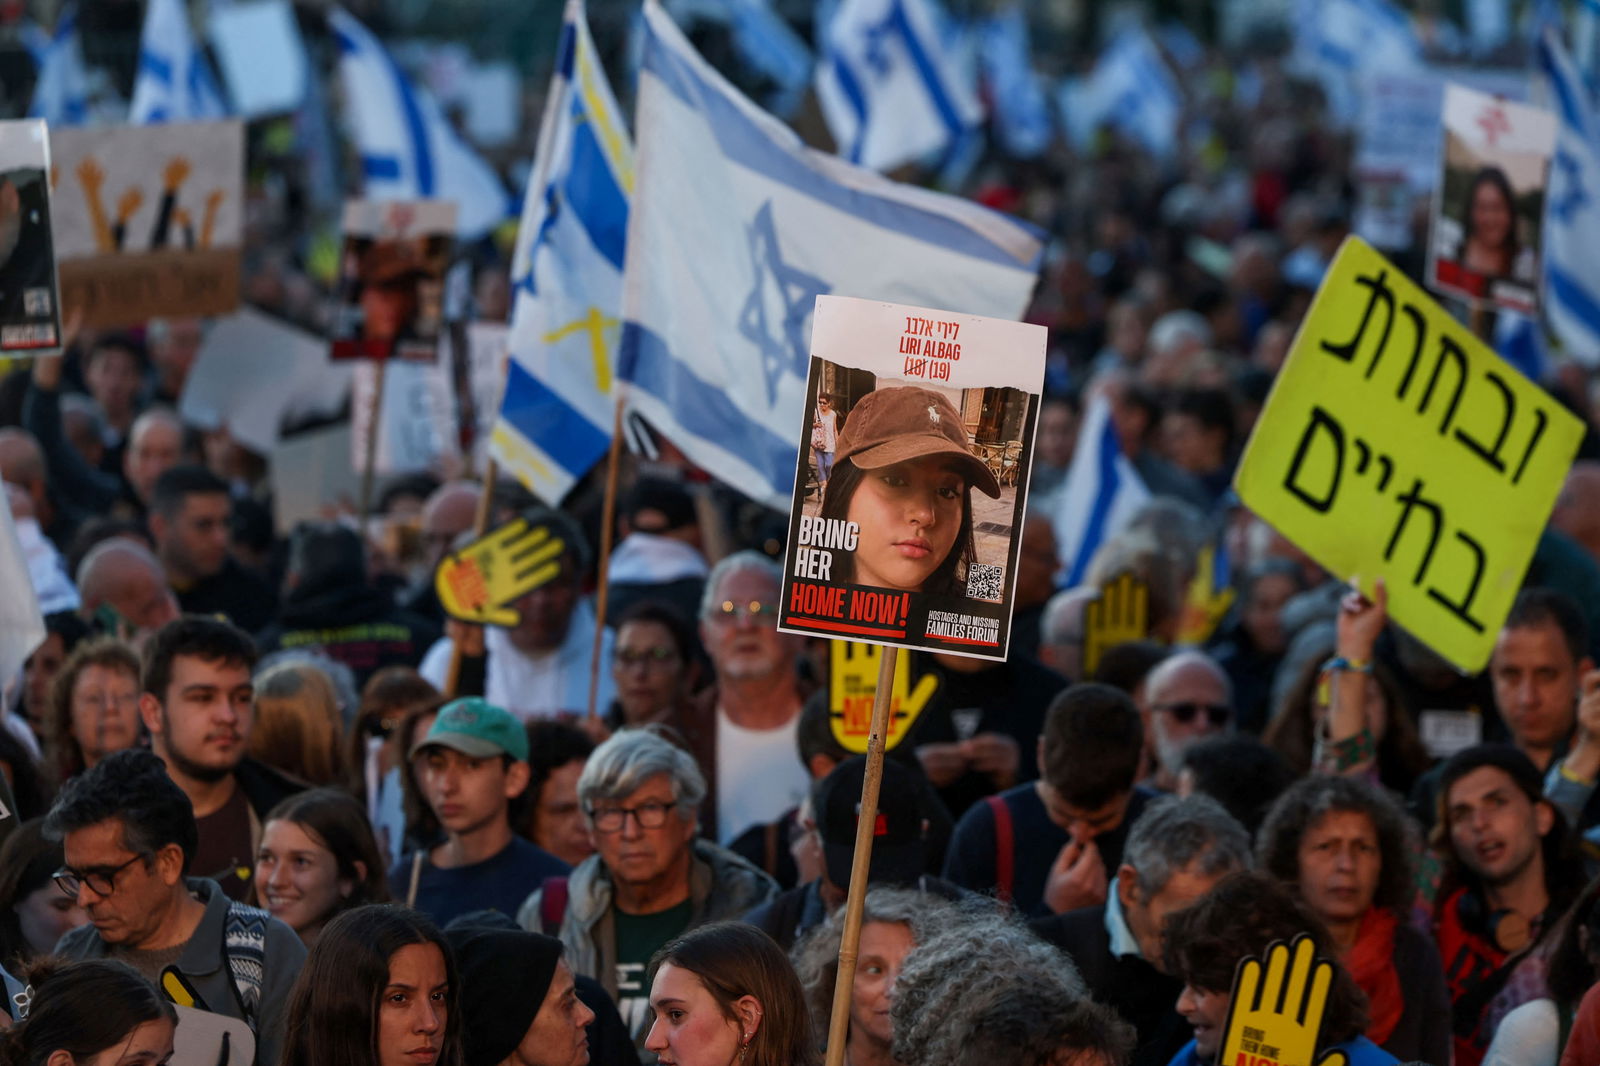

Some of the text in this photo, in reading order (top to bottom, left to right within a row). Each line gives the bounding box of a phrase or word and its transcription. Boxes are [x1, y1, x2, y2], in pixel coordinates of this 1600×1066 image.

[904, 316, 960, 340] לירי אלבג
[899, 336, 961, 361] LIRI ALBAG
[929, 359, 951, 382] (19)
[1319, 270, 1549, 486] ובחרת
[798, 514, 860, 552] BRING
[1282, 405, 1486, 635] בחיים
[794, 547, 833, 581] HER
[790, 582, 911, 627] HOME NOW!
[926, 620, 999, 644] FAMILIES FORUM
[928, 610, 1000, 629] HOSTAGES AND MISSING
